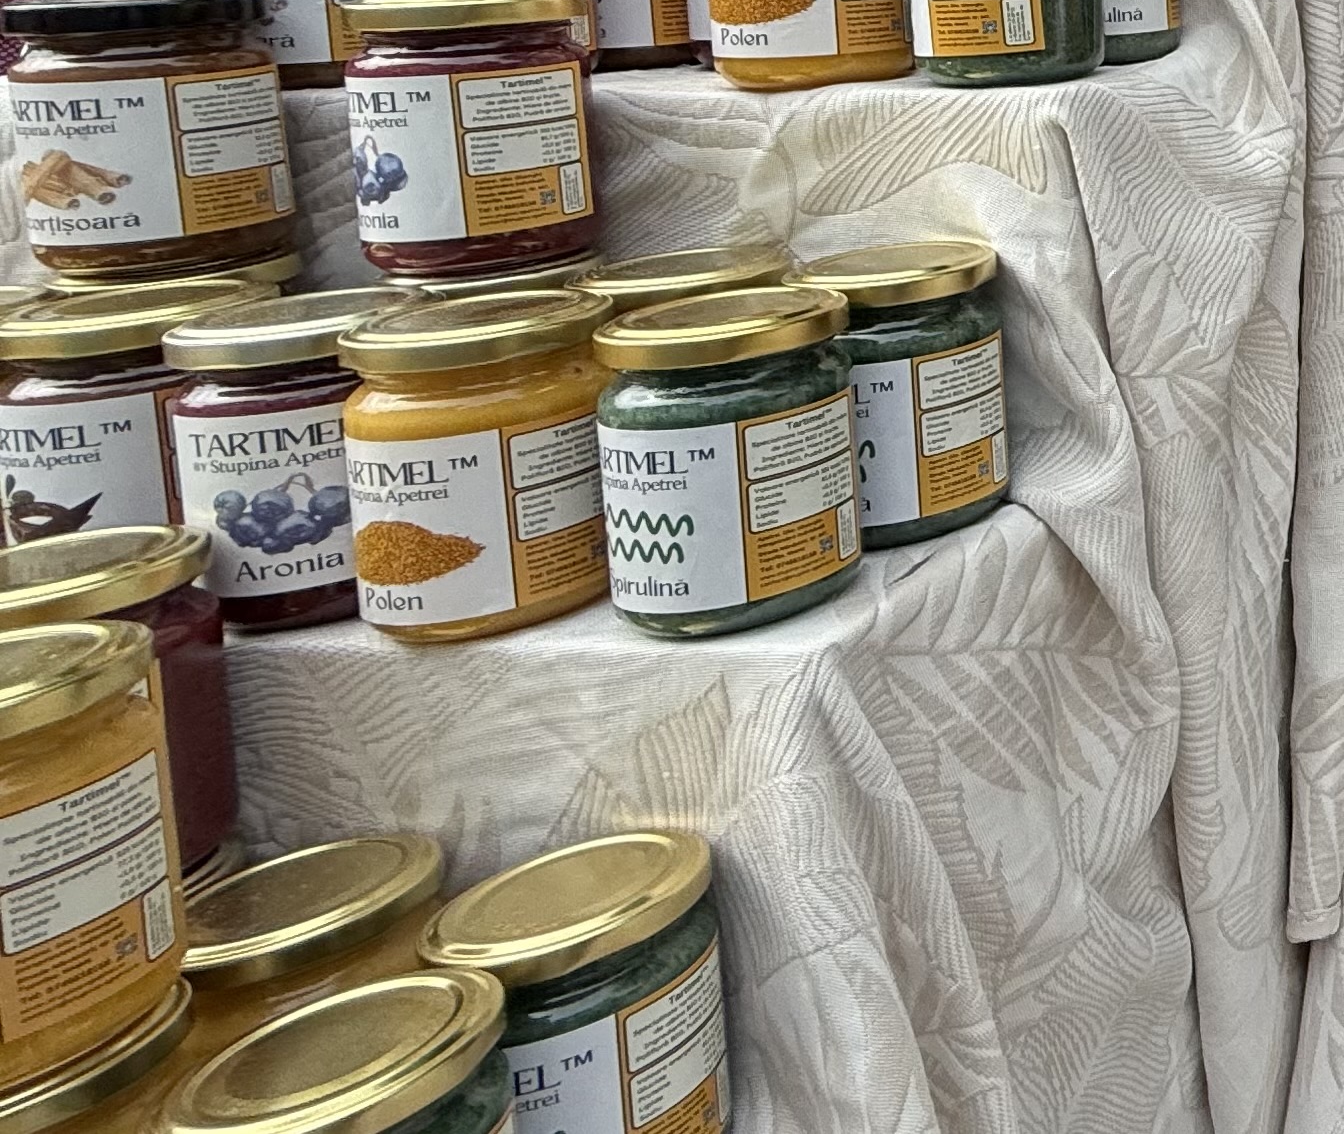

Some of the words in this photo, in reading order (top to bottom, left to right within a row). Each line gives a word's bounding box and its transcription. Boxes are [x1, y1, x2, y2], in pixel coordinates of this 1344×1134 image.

[1104, 6, 1143, 23] ulină
[720, 27, 769, 48] Polen
[54, 121, 118, 139] Apetrei
[360, 212, 400, 229] ronia
[33, 448, 102, 470] Apetrei
[209, 454, 281, 477] Stupina
[602, 447, 715, 475] RTIMEL™
[384, 485, 449, 506] Apetrei
[632, 476, 688, 495] Apetrei
[235, 549, 345, 582] Aronia
[365, 587, 424, 611] Polen
[515, 1089, 560, 1114] etrei
